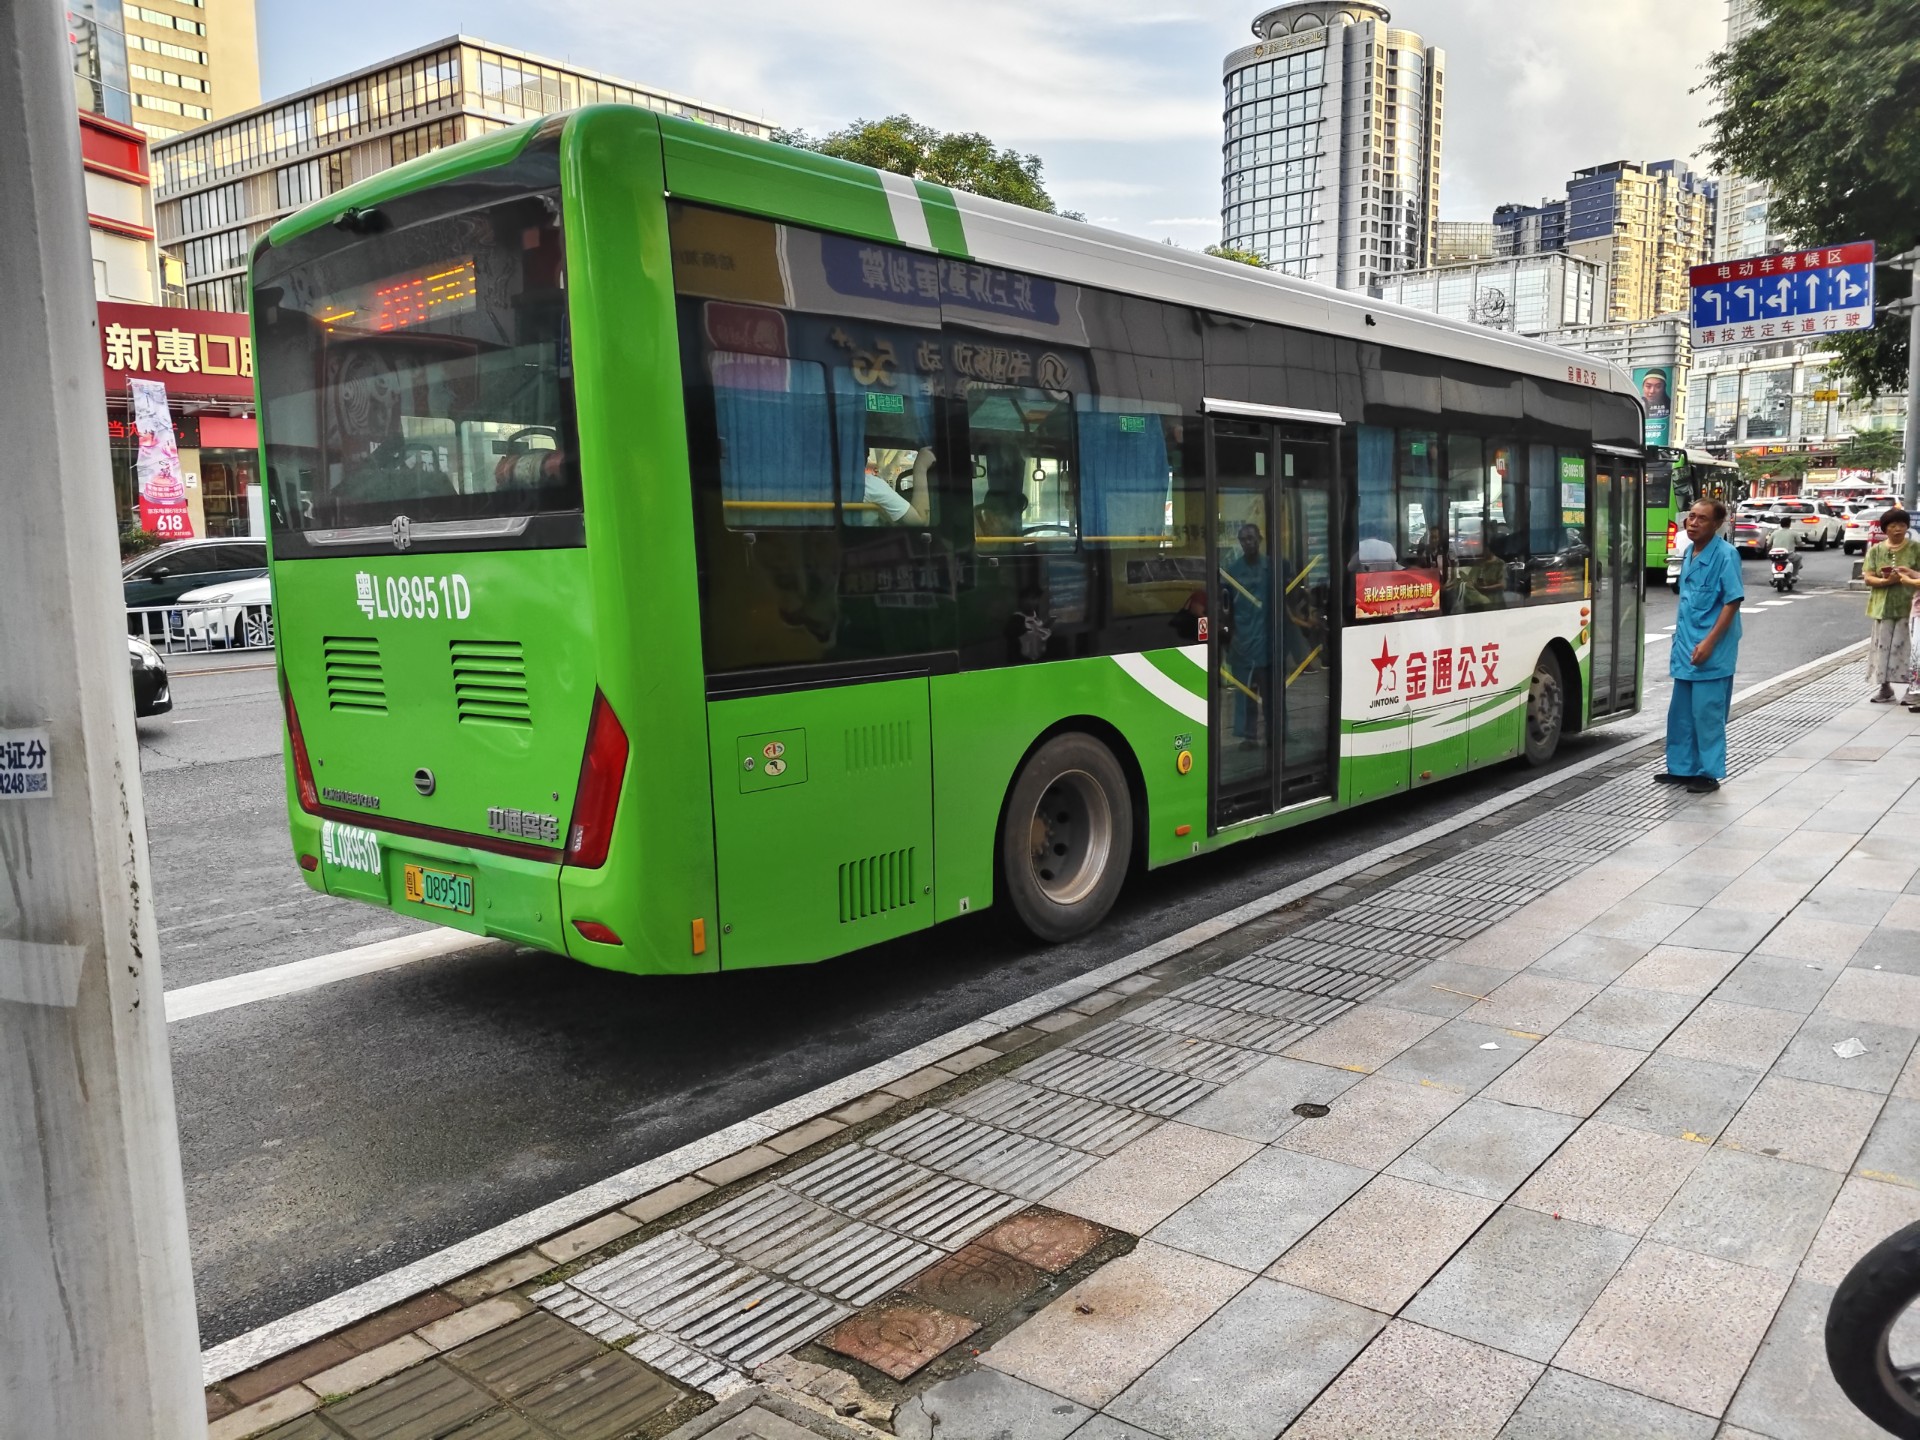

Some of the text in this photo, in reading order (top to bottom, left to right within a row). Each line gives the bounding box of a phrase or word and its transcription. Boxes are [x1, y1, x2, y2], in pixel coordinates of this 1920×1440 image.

[1717, 249, 1842, 279] 电动车等候区
[1702, 313, 1861, 344] 请按选定车道行驶
[1567, 366, 1597, 387] 金通公交
[157, 515, 183, 531] 618
[355, 570, 471, 620] 粤L08951D
[1363, 582, 1434, 603] 深化全国文明城市创建
[1405, 642, 1499, 702] 金通公交
[1369, 696, 1399, 709] JINTONG
[487, 806, 559, 842] 中通客车
[322, 820, 381, 876] 粤L08951D
